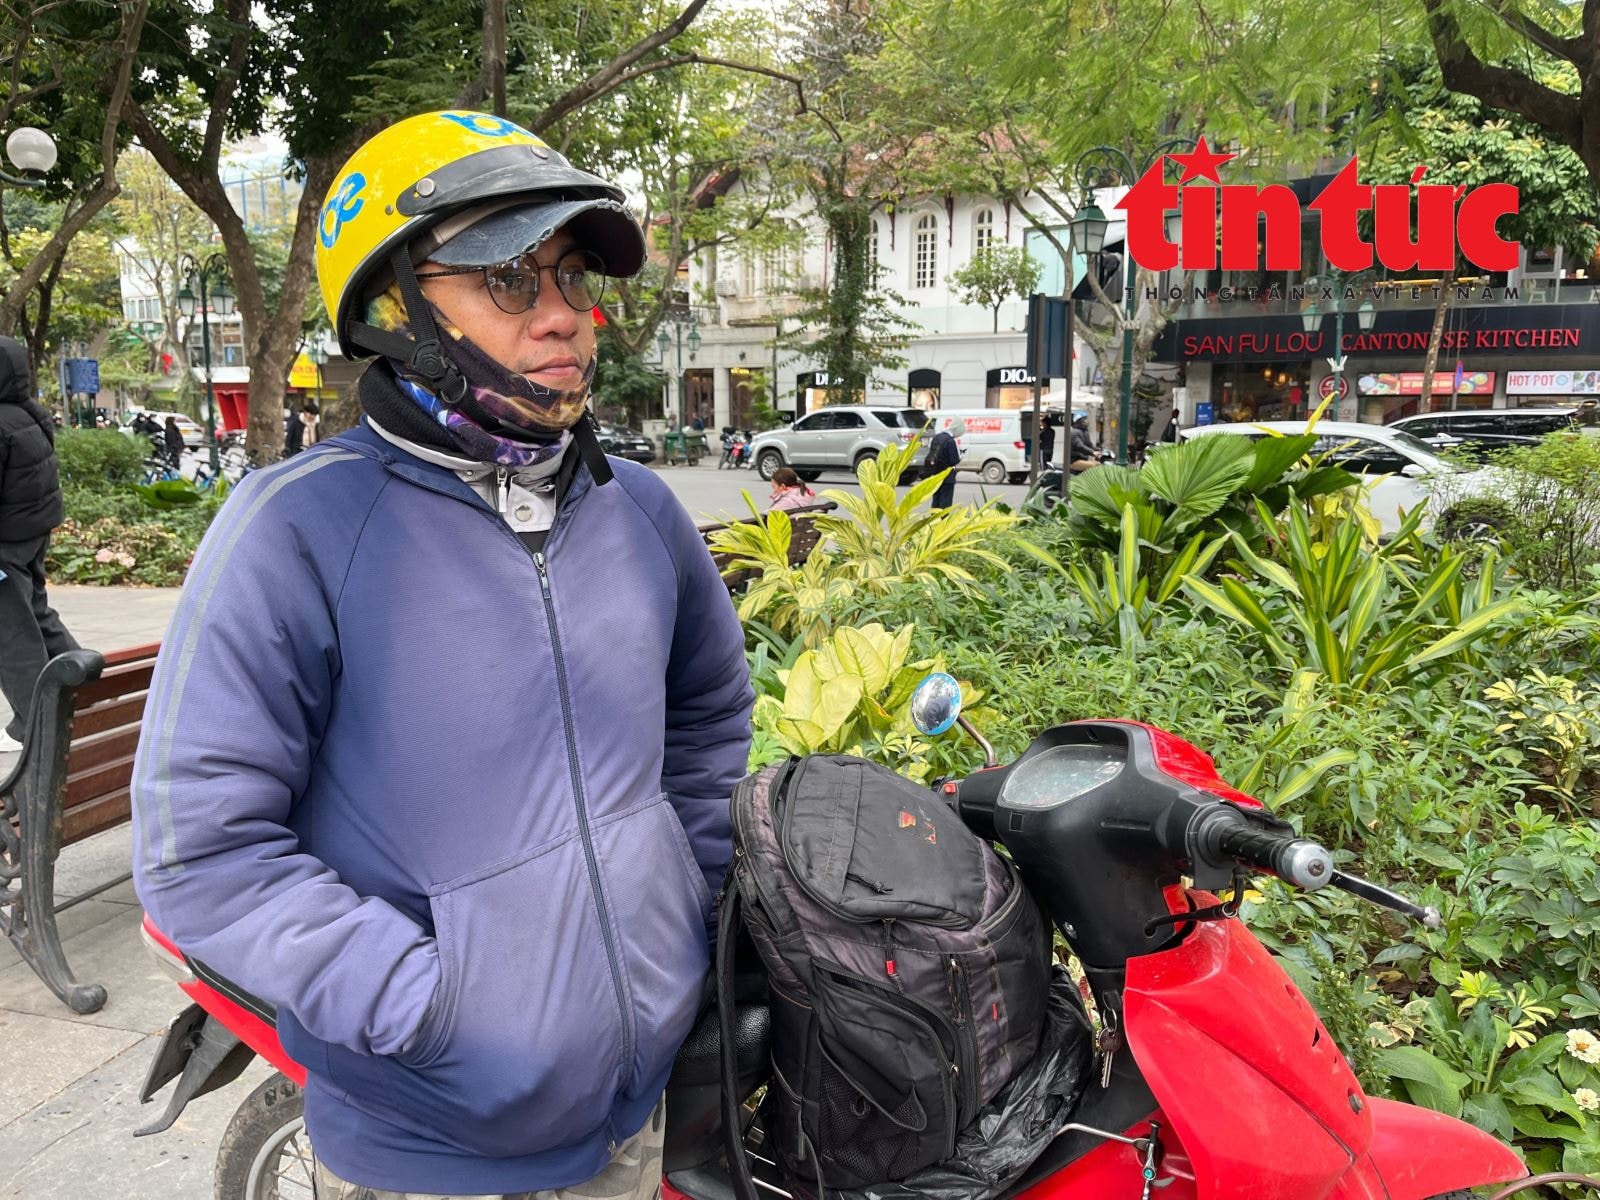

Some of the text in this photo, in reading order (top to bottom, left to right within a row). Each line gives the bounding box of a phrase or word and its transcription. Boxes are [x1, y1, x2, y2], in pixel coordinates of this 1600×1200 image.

[1184, 332, 1324, 356] SAN FU LOU
[1340, 328, 1581, 351] CANTONSE KITCHEN
[1508, 375, 1555, 386] HOT POT
